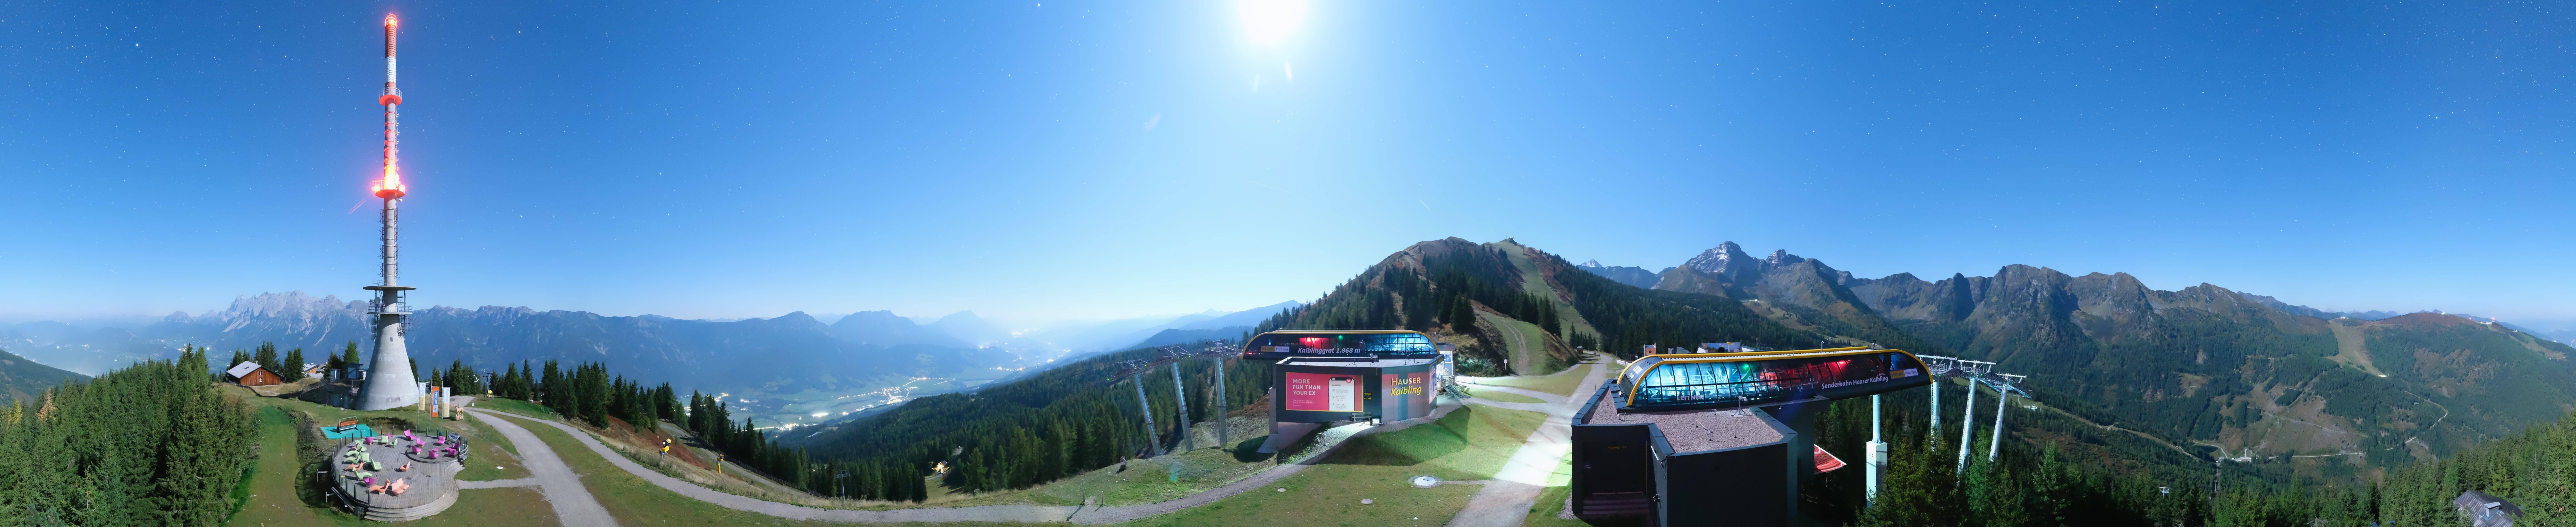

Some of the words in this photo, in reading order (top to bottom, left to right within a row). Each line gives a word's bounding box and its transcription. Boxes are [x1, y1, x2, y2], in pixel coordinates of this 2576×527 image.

[1391, 377, 1421, 386] HAUSER
[1822, 380, 1852, 389] Senderbahn
[1391, 386, 1421, 396] Kaibling
